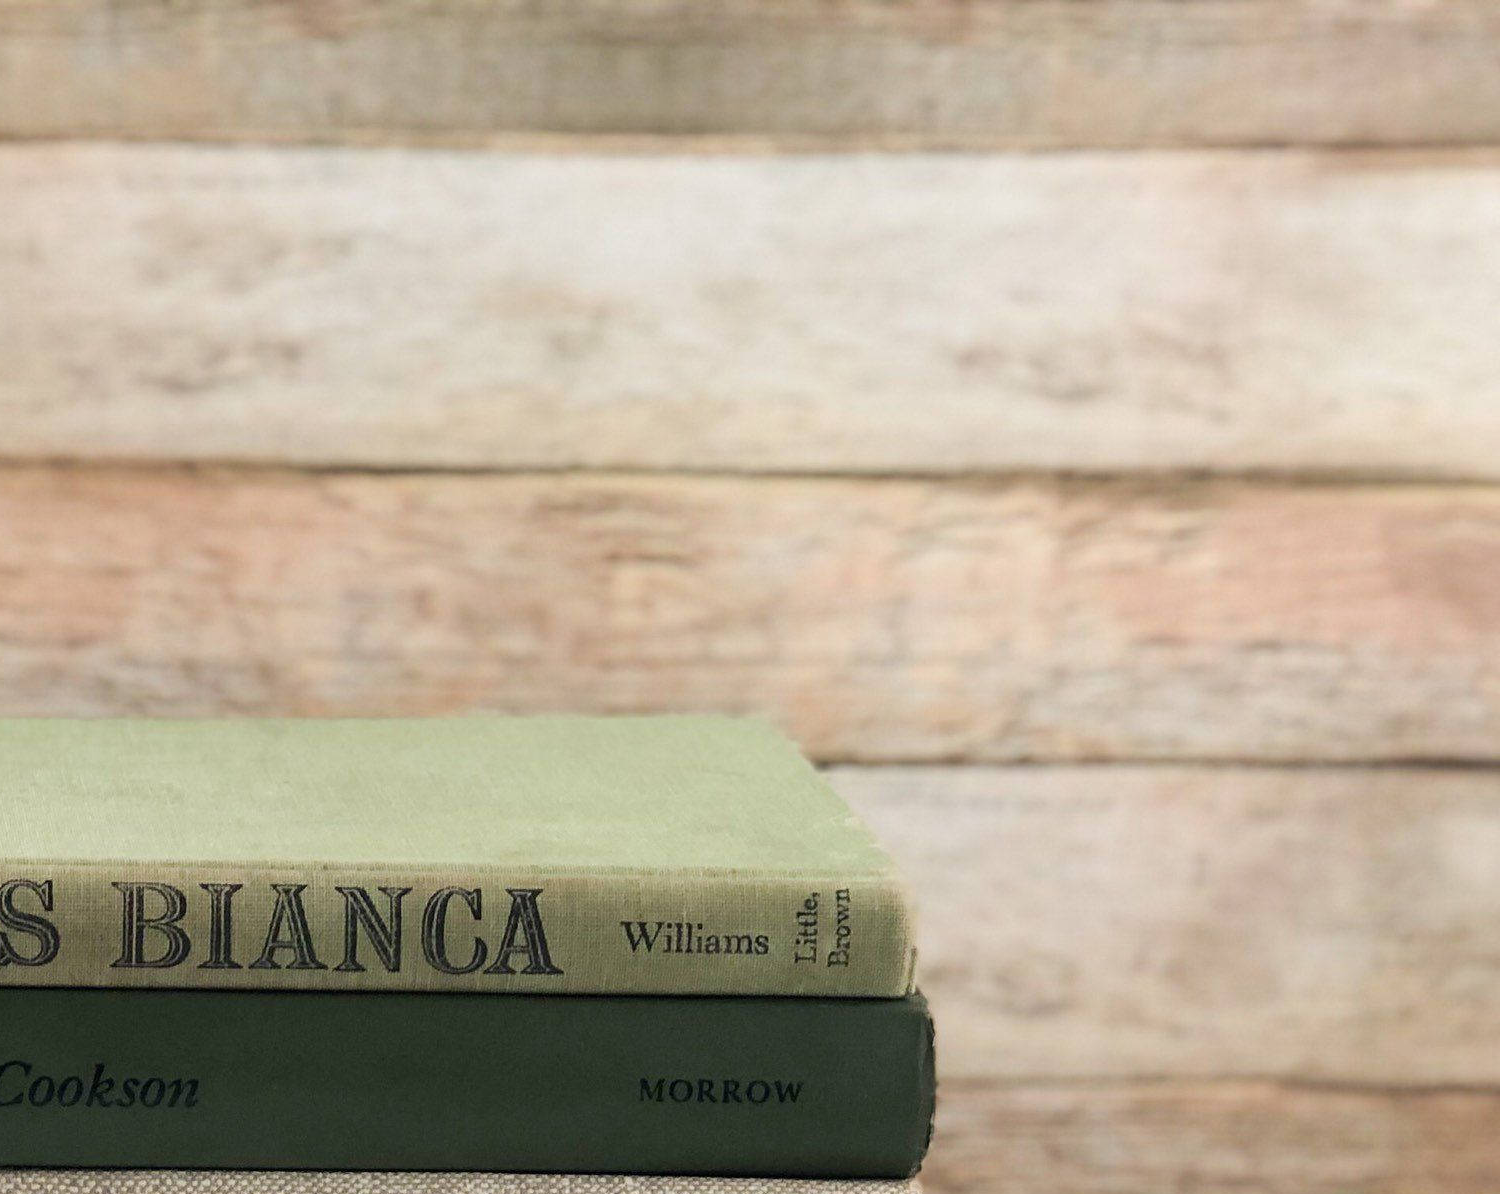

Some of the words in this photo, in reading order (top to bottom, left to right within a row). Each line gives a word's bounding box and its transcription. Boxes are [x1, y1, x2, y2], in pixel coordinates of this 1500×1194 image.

[110, 880, 564, 977] BIANCA
[620, 921, 770, 957] Williams
[794, 891, 820, 964] Little,
[827, 888, 851, 968] Brown
[638, 1078, 805, 1105] MORROW
